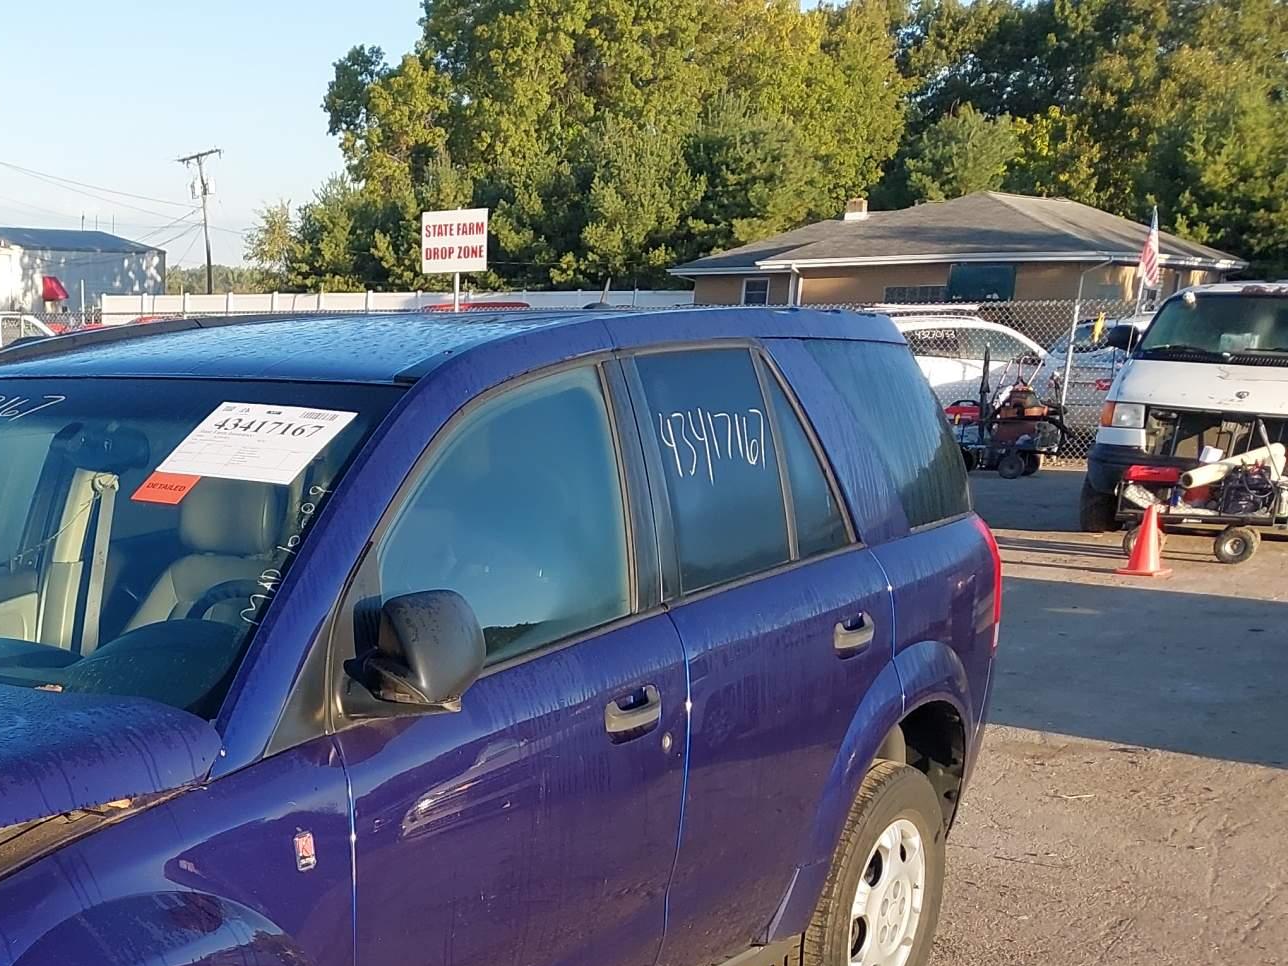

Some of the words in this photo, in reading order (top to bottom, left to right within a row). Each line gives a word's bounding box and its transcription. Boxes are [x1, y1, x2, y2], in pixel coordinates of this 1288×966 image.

[425, 223, 455, 238] STATE
[456, 221, 485, 236] FARM
[425, 246, 455, 261] DROP
[456, 244, 485, 259] ZONE
[214, 417, 326, 439] 43417167
[657, 407, 766, 487] 43417167
[145, 482, 187, 492] DETAILED
